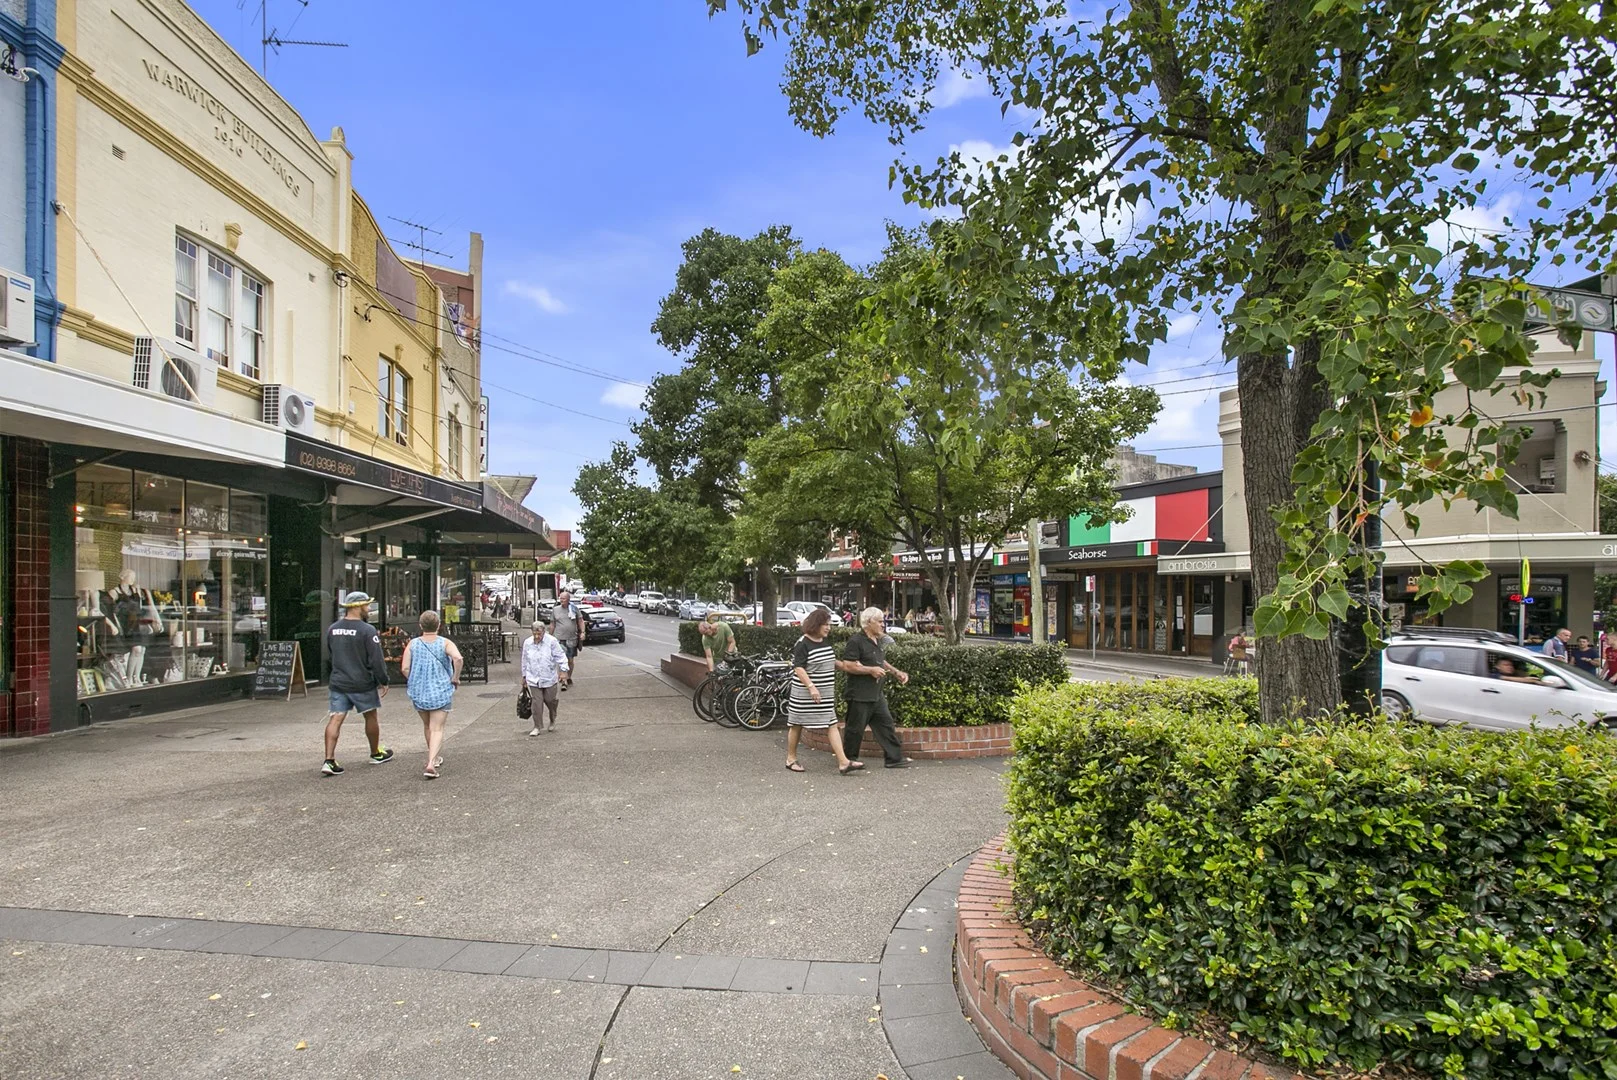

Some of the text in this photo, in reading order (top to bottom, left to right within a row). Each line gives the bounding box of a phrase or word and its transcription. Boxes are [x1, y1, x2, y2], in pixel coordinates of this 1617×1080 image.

[142, 58, 301, 198] WARWICK BUILDINGS
[300, 451, 315, 469] (02)
[390, 469, 406, 486] LIVE
[1068, 548, 1107, 560] Seahorse
[1167, 556, 1218, 571] ambrosia
[262, 643, 278, 652] LIVE
